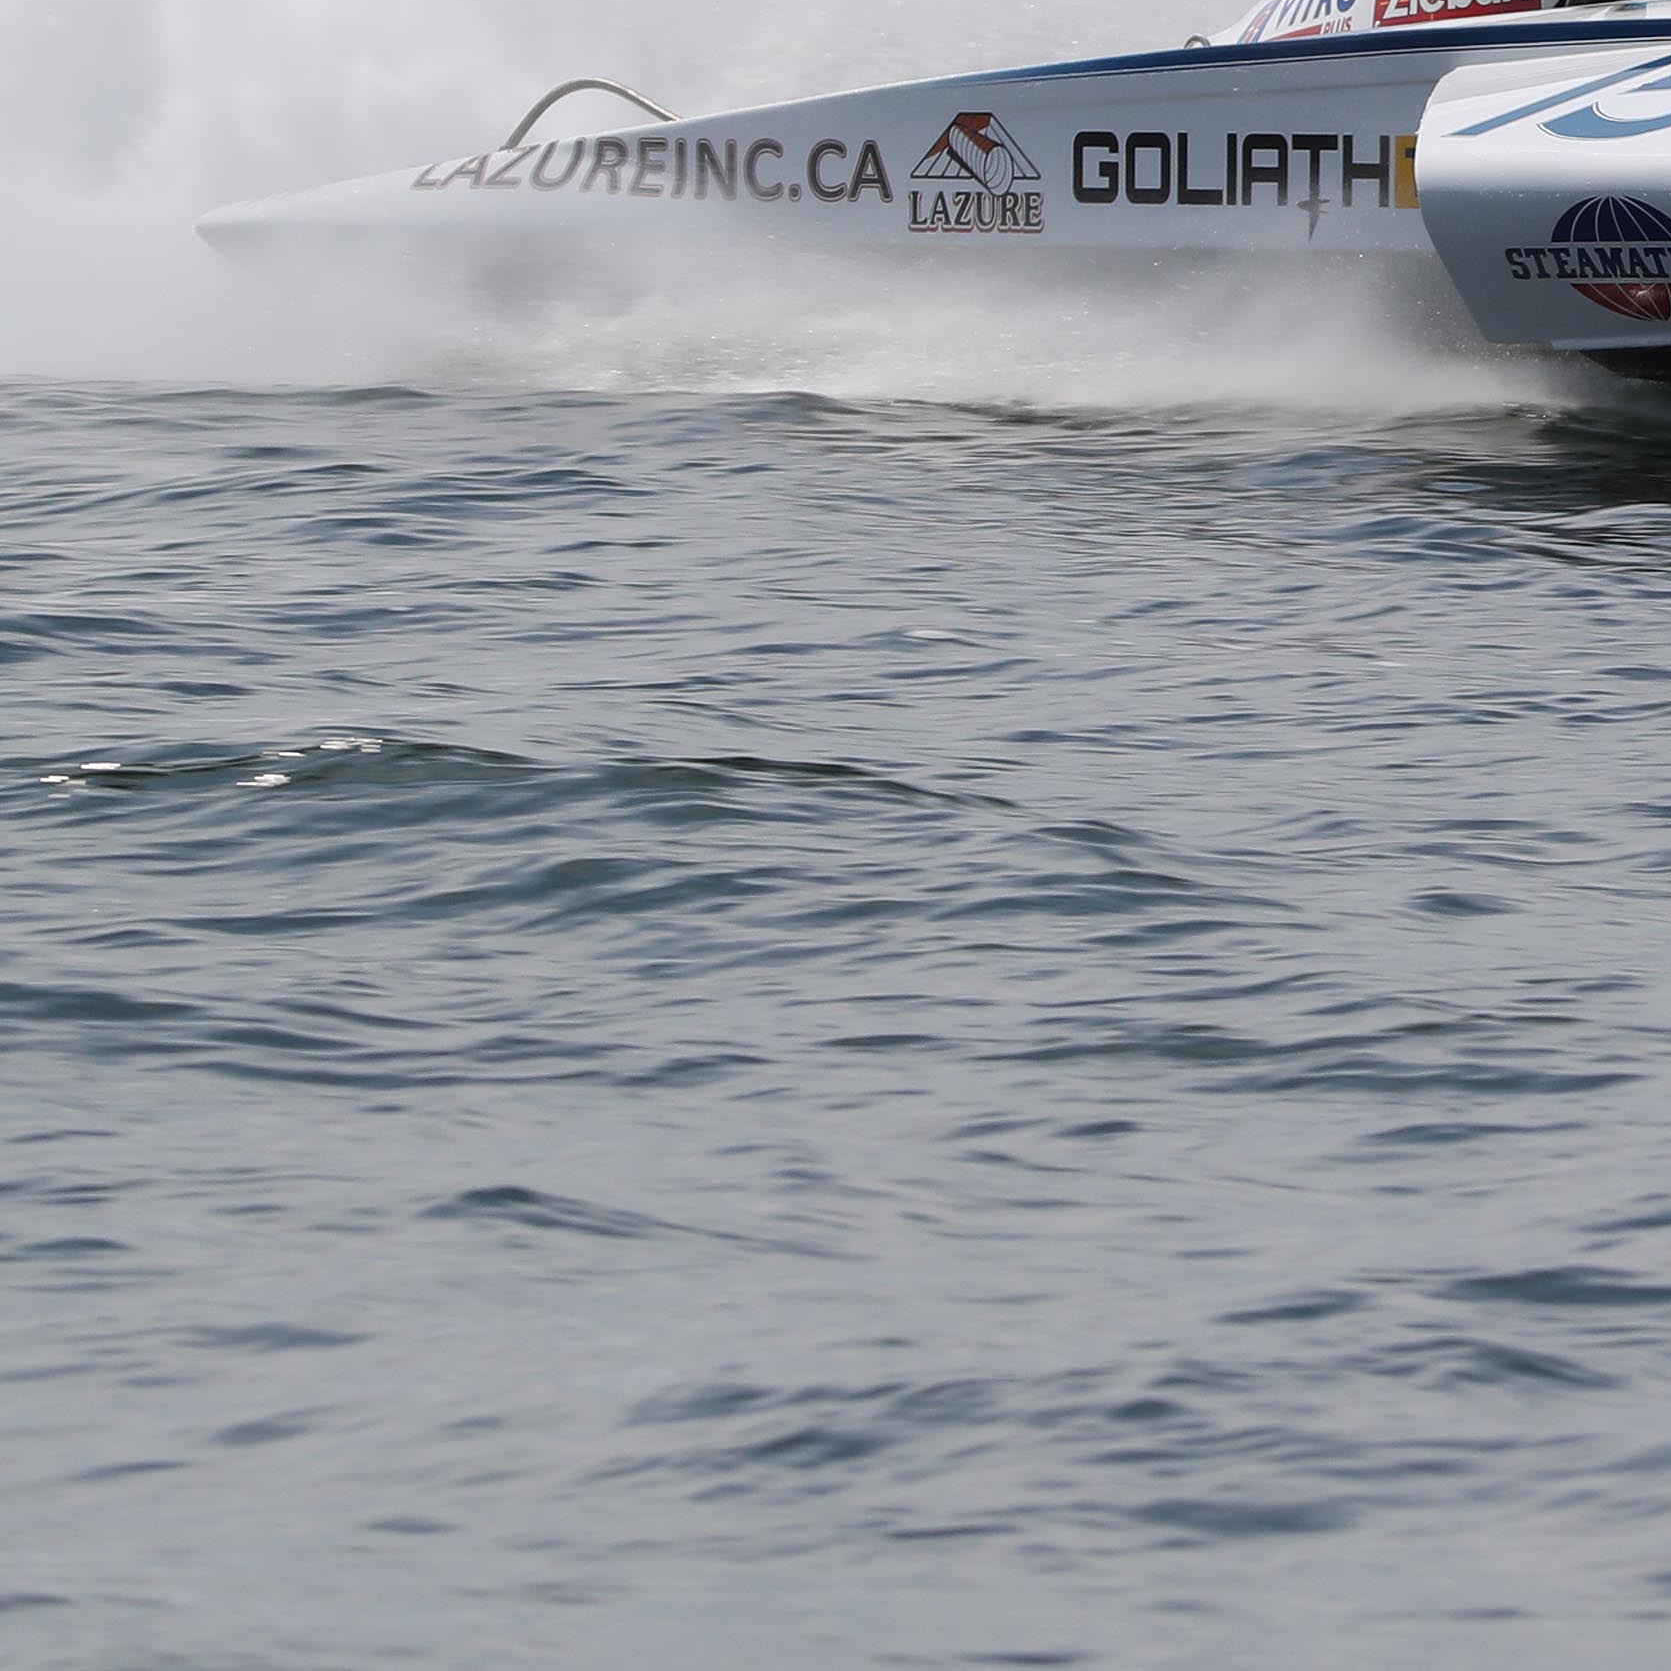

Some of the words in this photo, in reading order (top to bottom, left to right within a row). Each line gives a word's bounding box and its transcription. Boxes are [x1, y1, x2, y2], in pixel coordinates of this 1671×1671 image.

[410, 136, 893, 203] LAZUREINC.CA
[1072, 132, 1390, 207] GOLIATH
[908, 189, 1045, 233] LAZURE
